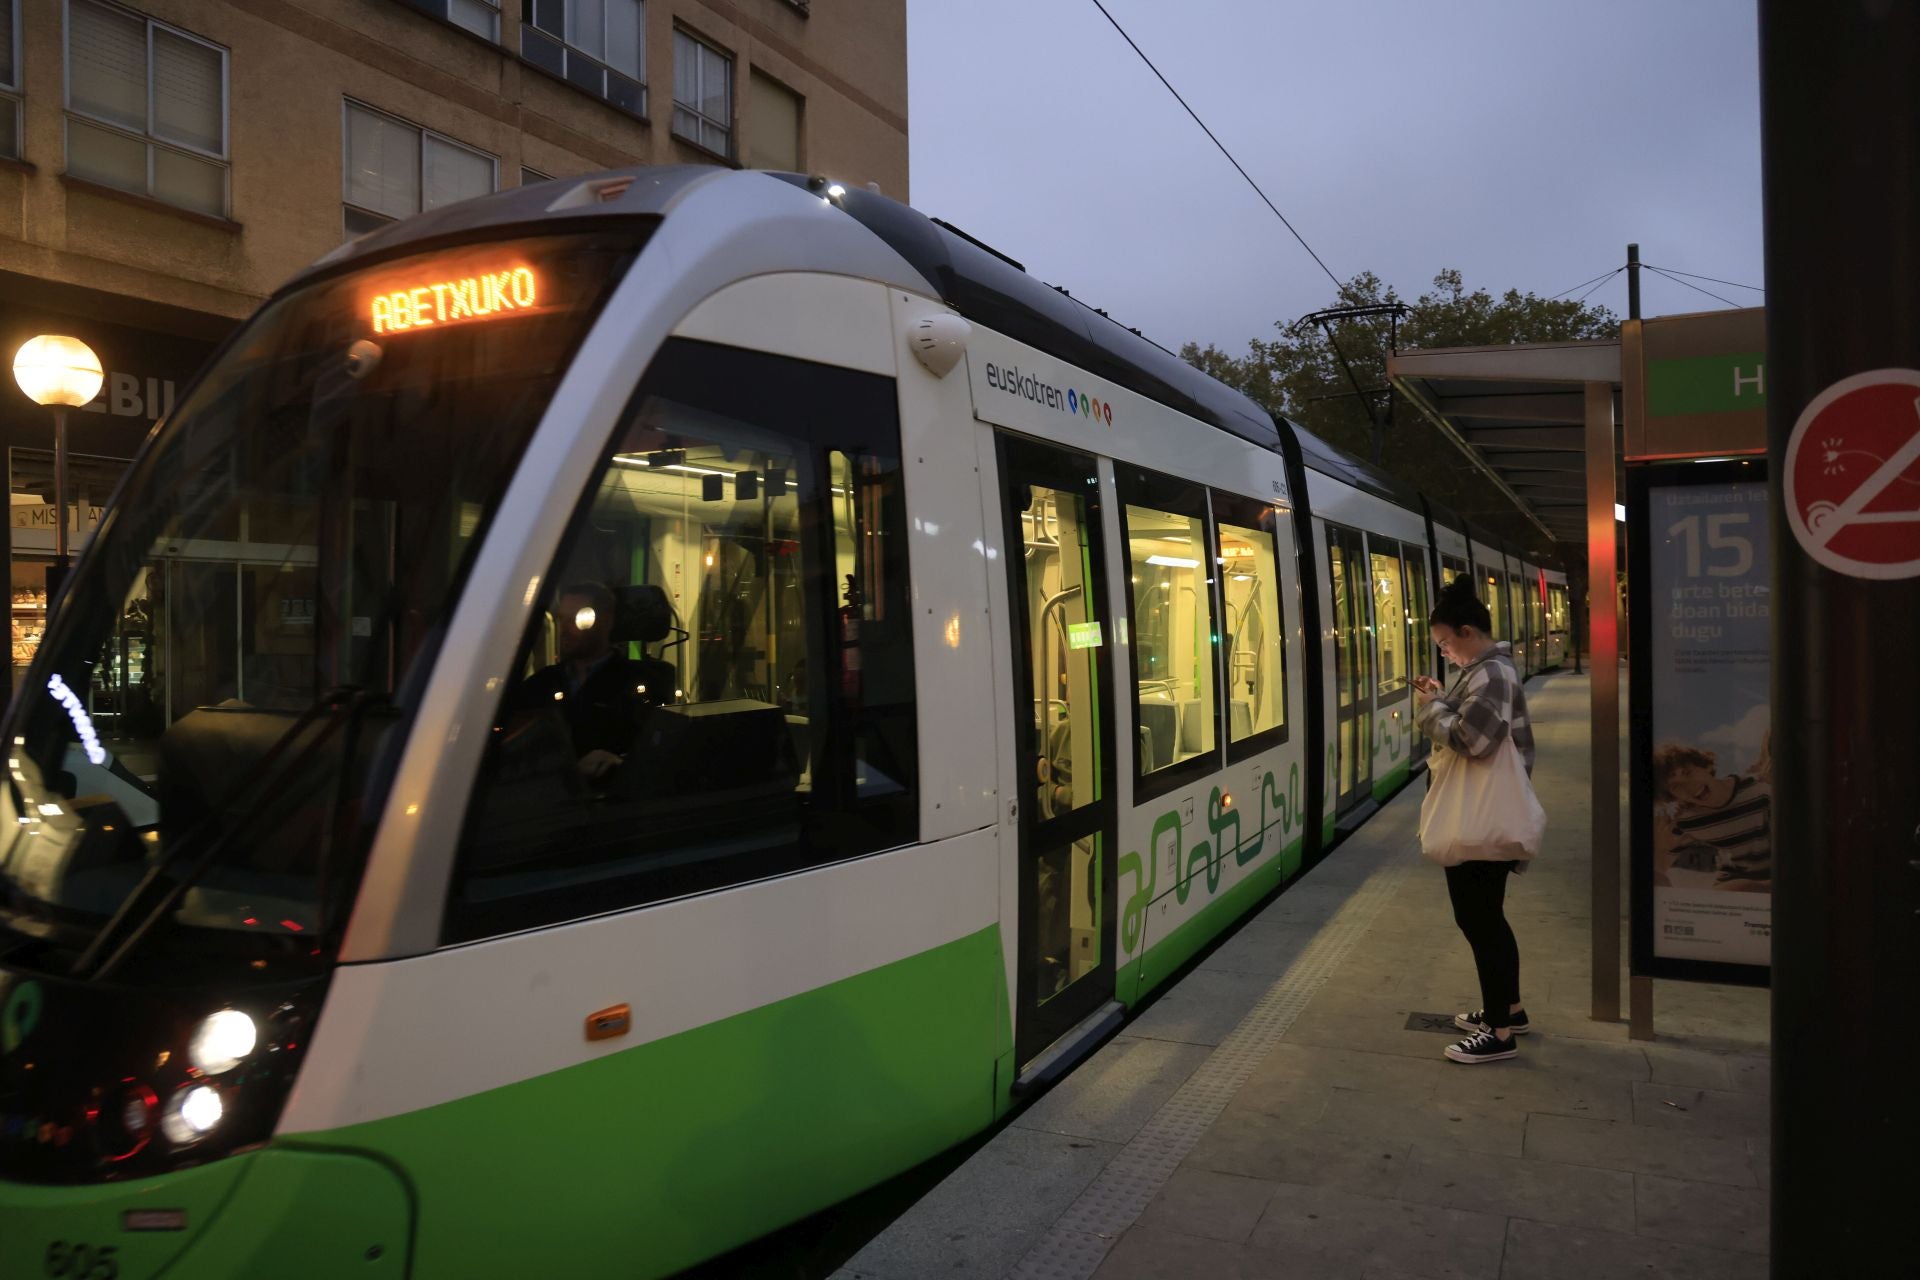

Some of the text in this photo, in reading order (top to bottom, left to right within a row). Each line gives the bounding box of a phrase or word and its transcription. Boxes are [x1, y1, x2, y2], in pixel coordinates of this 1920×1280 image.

[372, 267, 536, 333] ABETXUKO
[986, 361, 1065, 412] euskotren
[1667, 513, 1753, 578] 15
[1671, 622, 1722, 643] dugu
